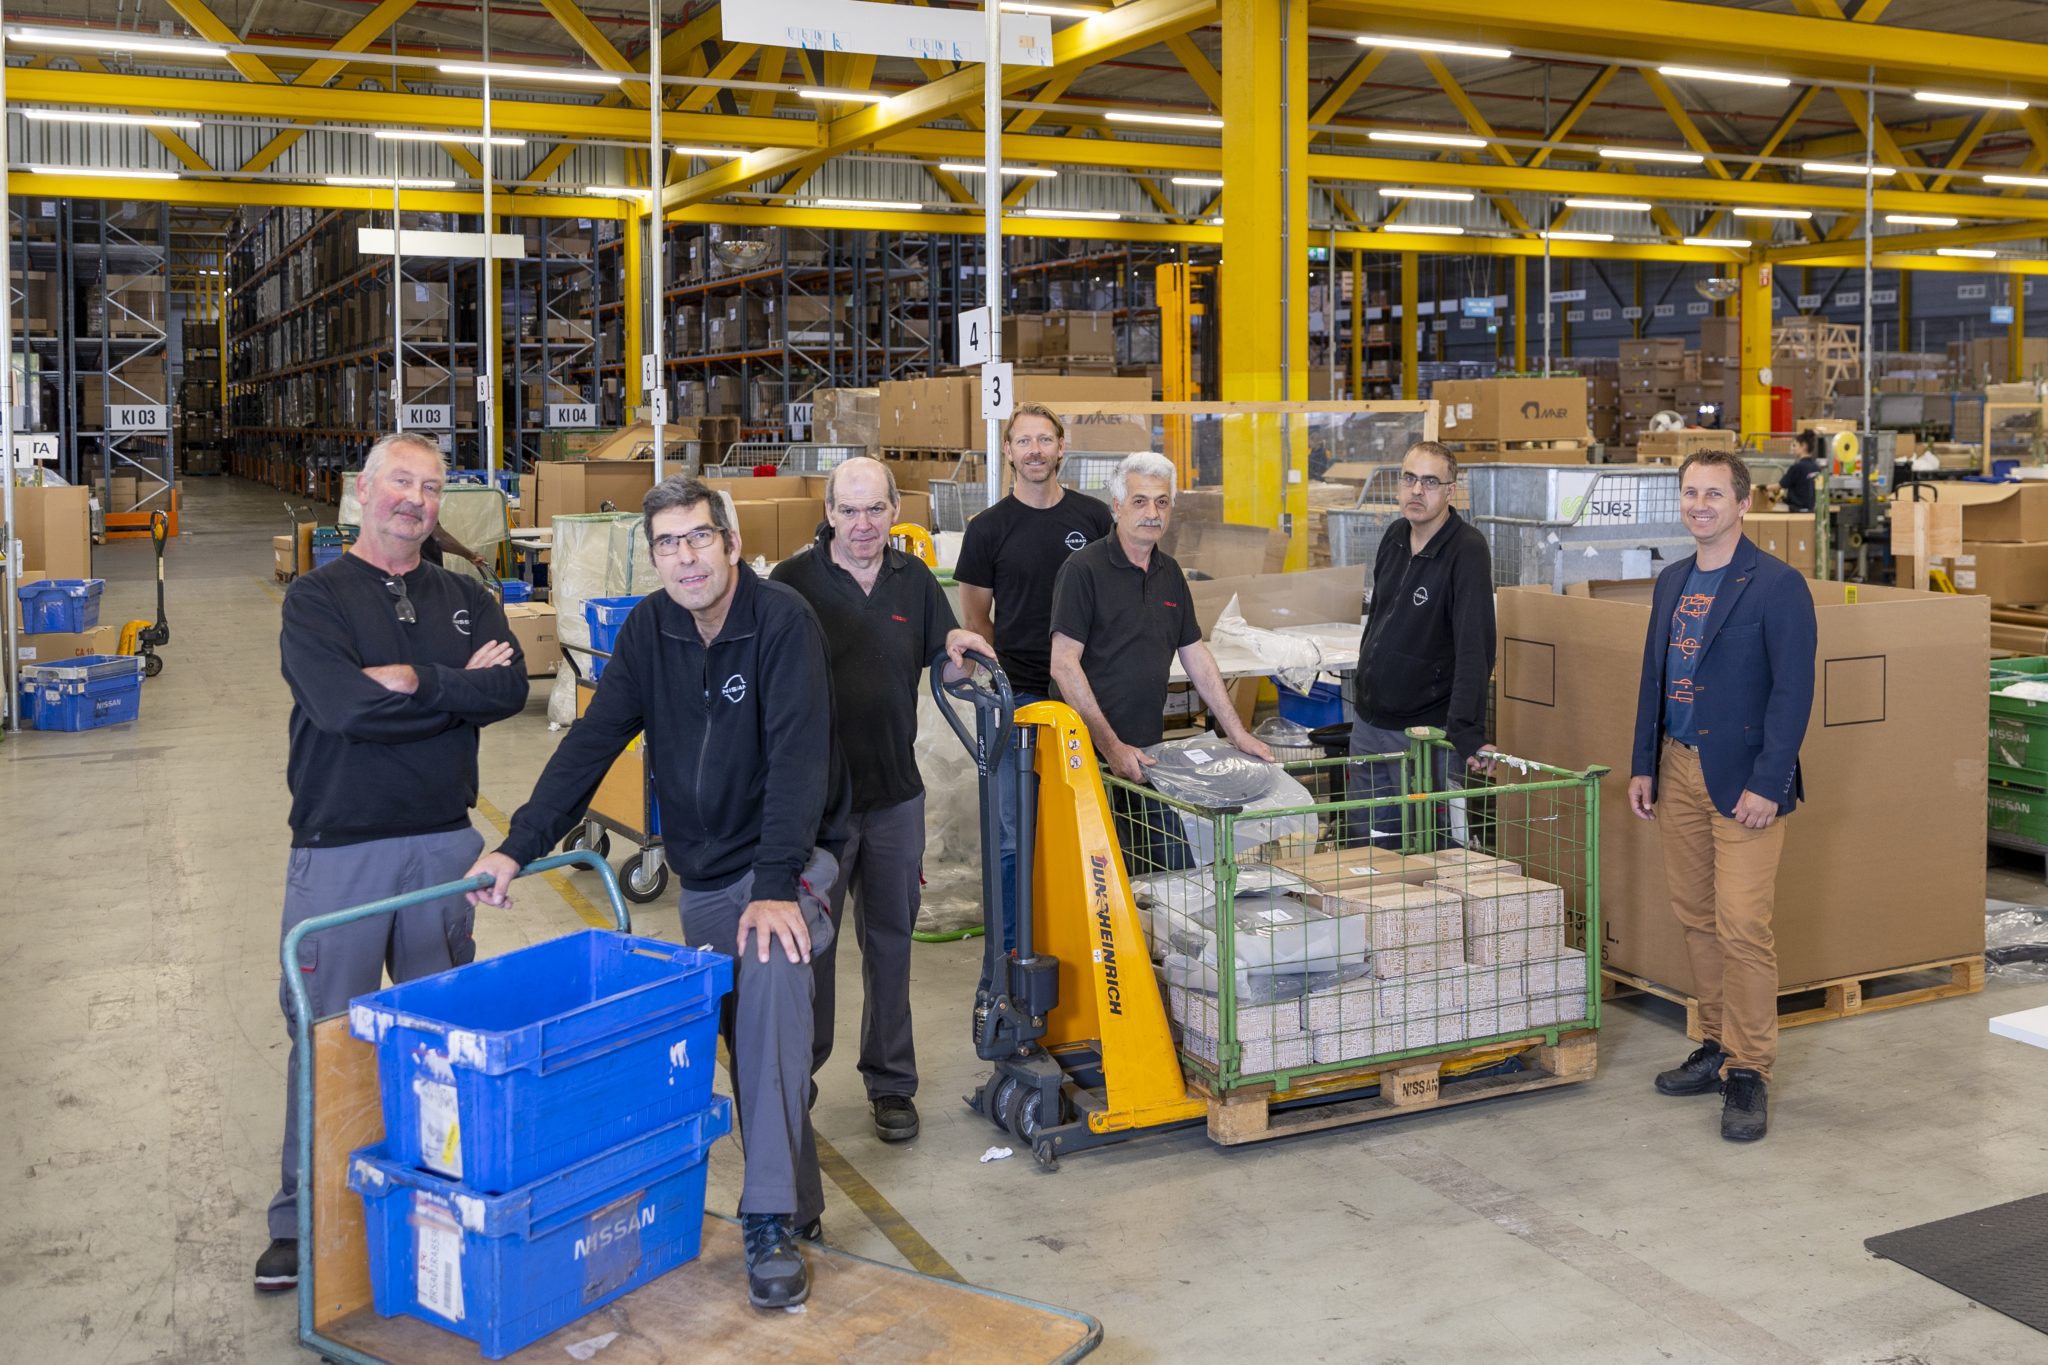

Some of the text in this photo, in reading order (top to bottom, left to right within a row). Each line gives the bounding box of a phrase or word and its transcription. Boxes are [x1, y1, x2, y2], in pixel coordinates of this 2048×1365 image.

[970, 322, 978, 351] 4
[646, 363, 650, 381] 6
[993, 376, 1001, 406] 3
[411, 409, 423, 423] KI
[426, 409, 441, 423] 03
[558, 408, 587, 422] KI 04
[656, 398, 660, 417] 5
[122, 410, 156, 425] KI 03
[97, 699, 122, 709] NISSAN
[1988, 728, 2030, 743] NISSAN
[1987, 797, 2030, 814] NISSAN
[1402, 1078, 1438, 1097] NISSAN
[574, 1204, 656, 1260] NISSAN
